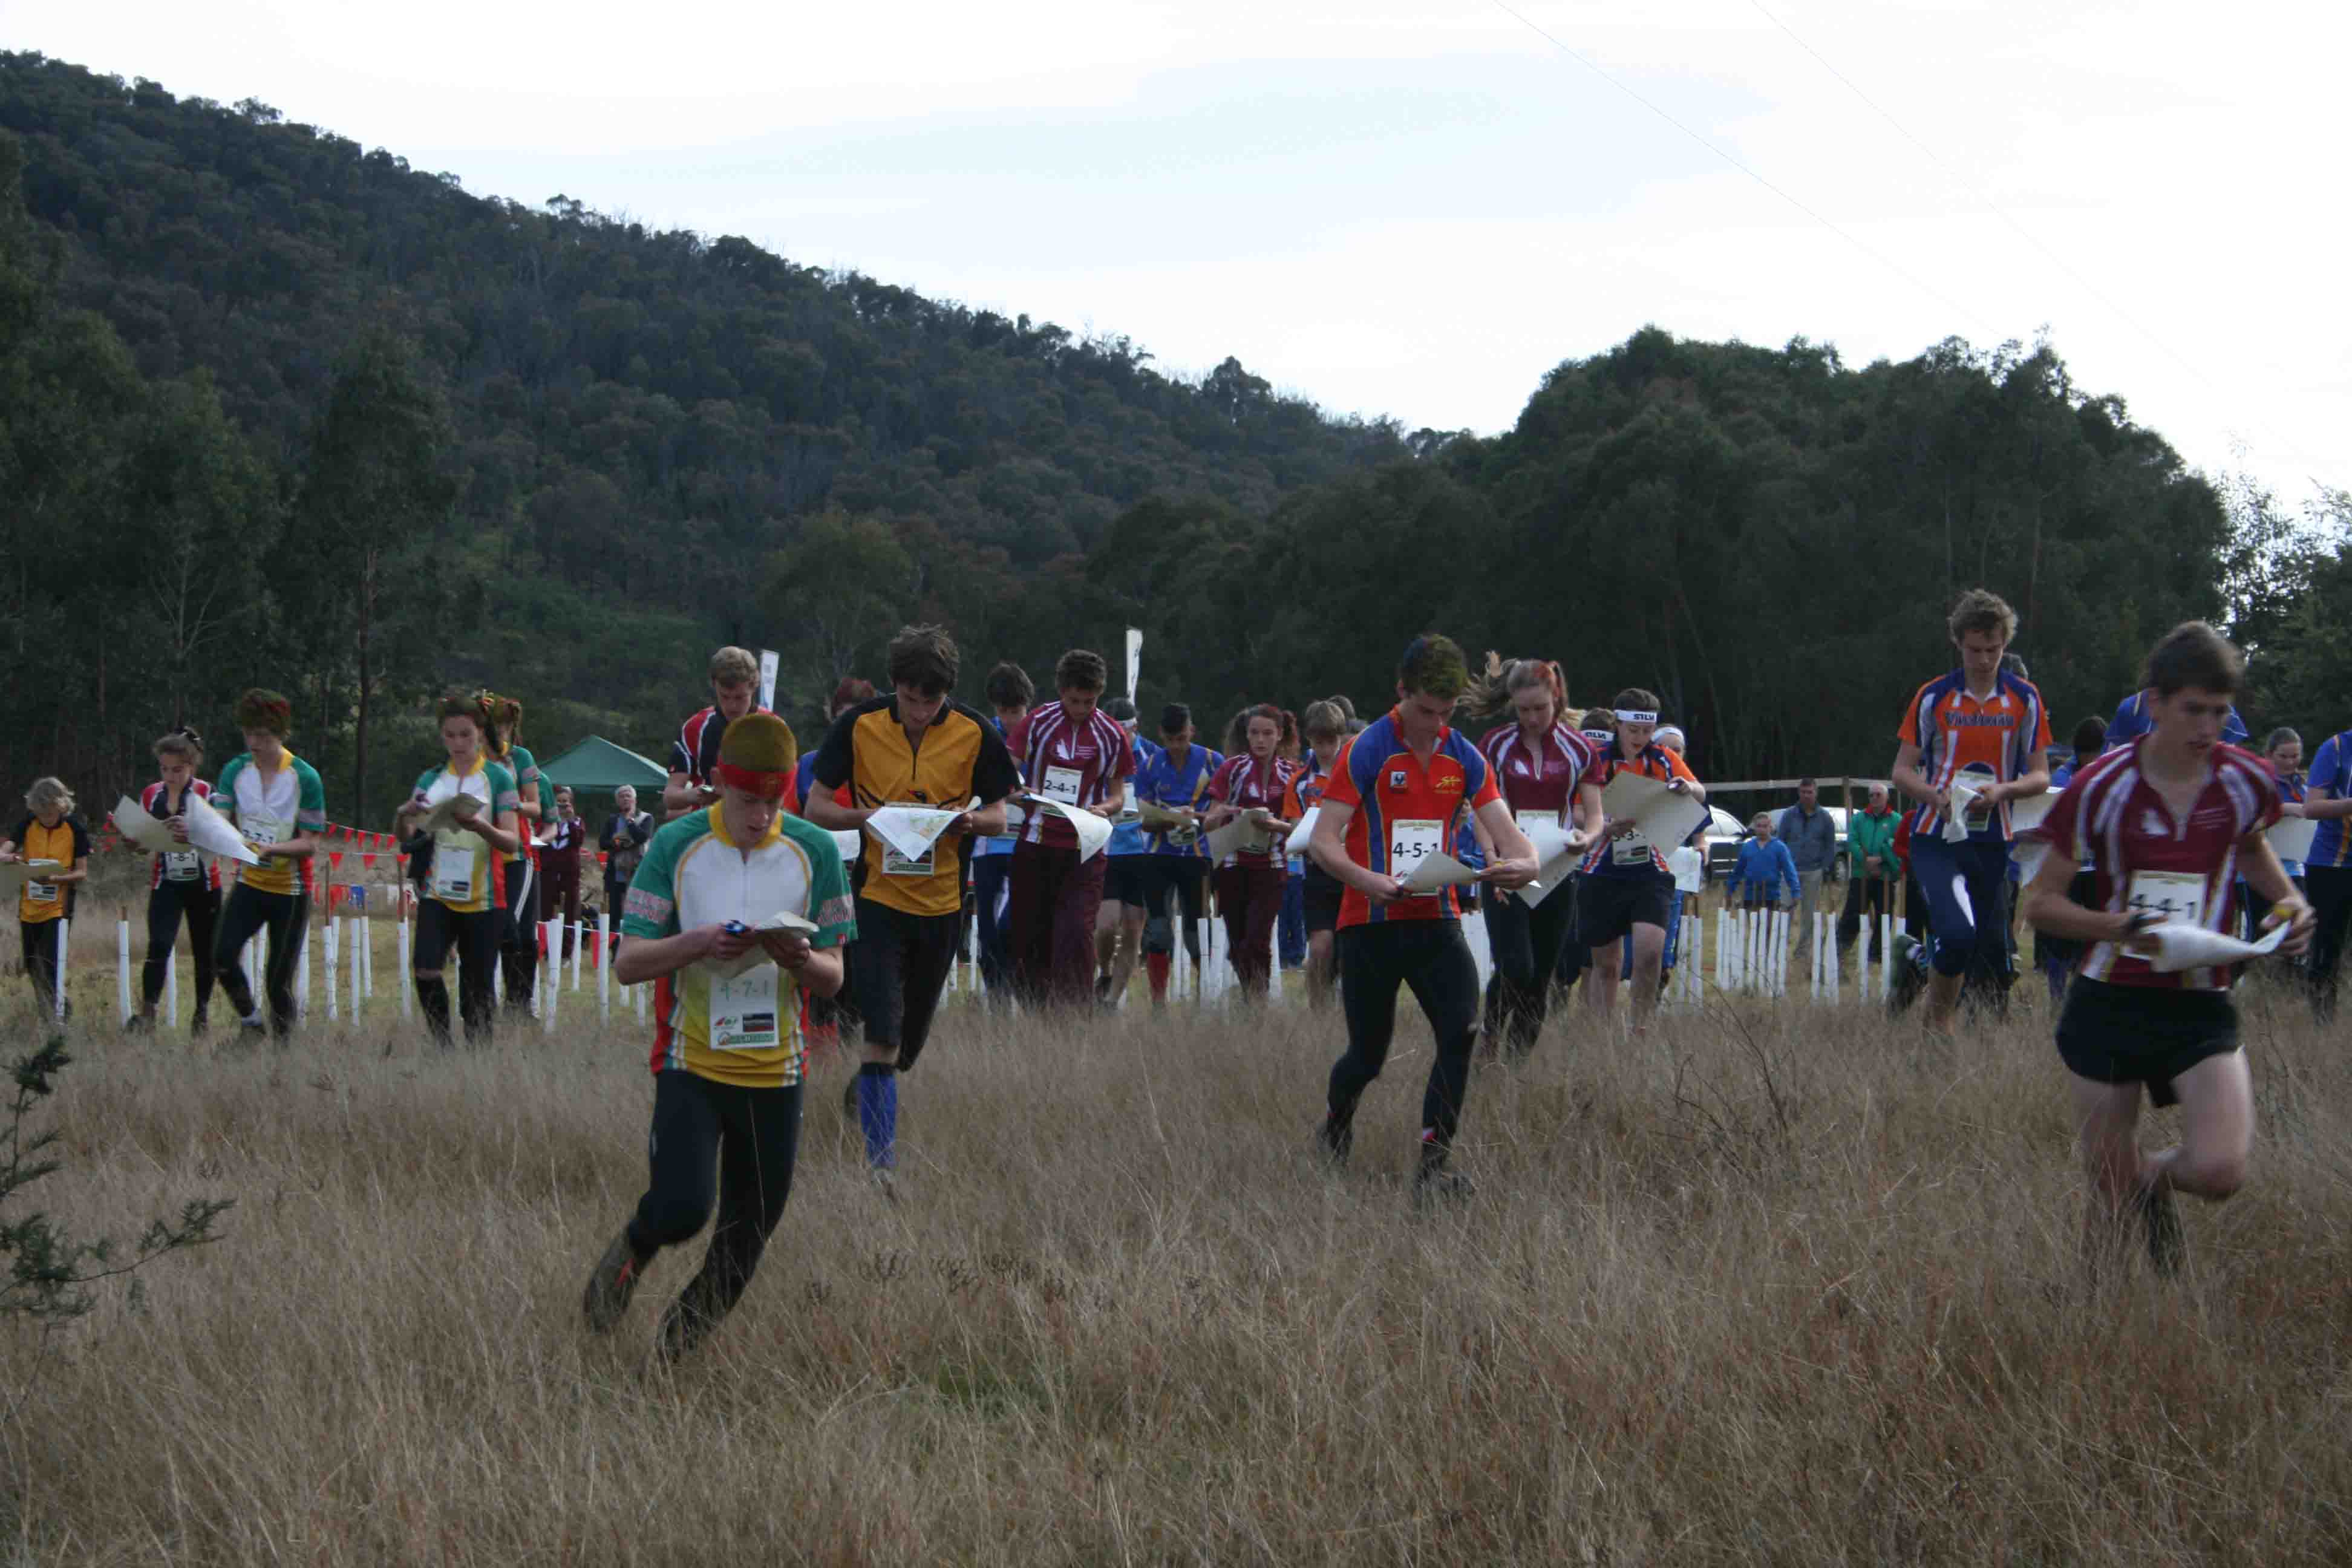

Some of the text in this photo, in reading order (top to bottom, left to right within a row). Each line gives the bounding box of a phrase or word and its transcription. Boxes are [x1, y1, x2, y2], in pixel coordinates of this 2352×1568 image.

[1044, 780, 1077, 794] 2-4-1
[167, 852, 197, 862] 1-8-1
[1393, 842, 1438, 858] 4-5-1
[2129, 893, 2196, 920] 4-4-1
